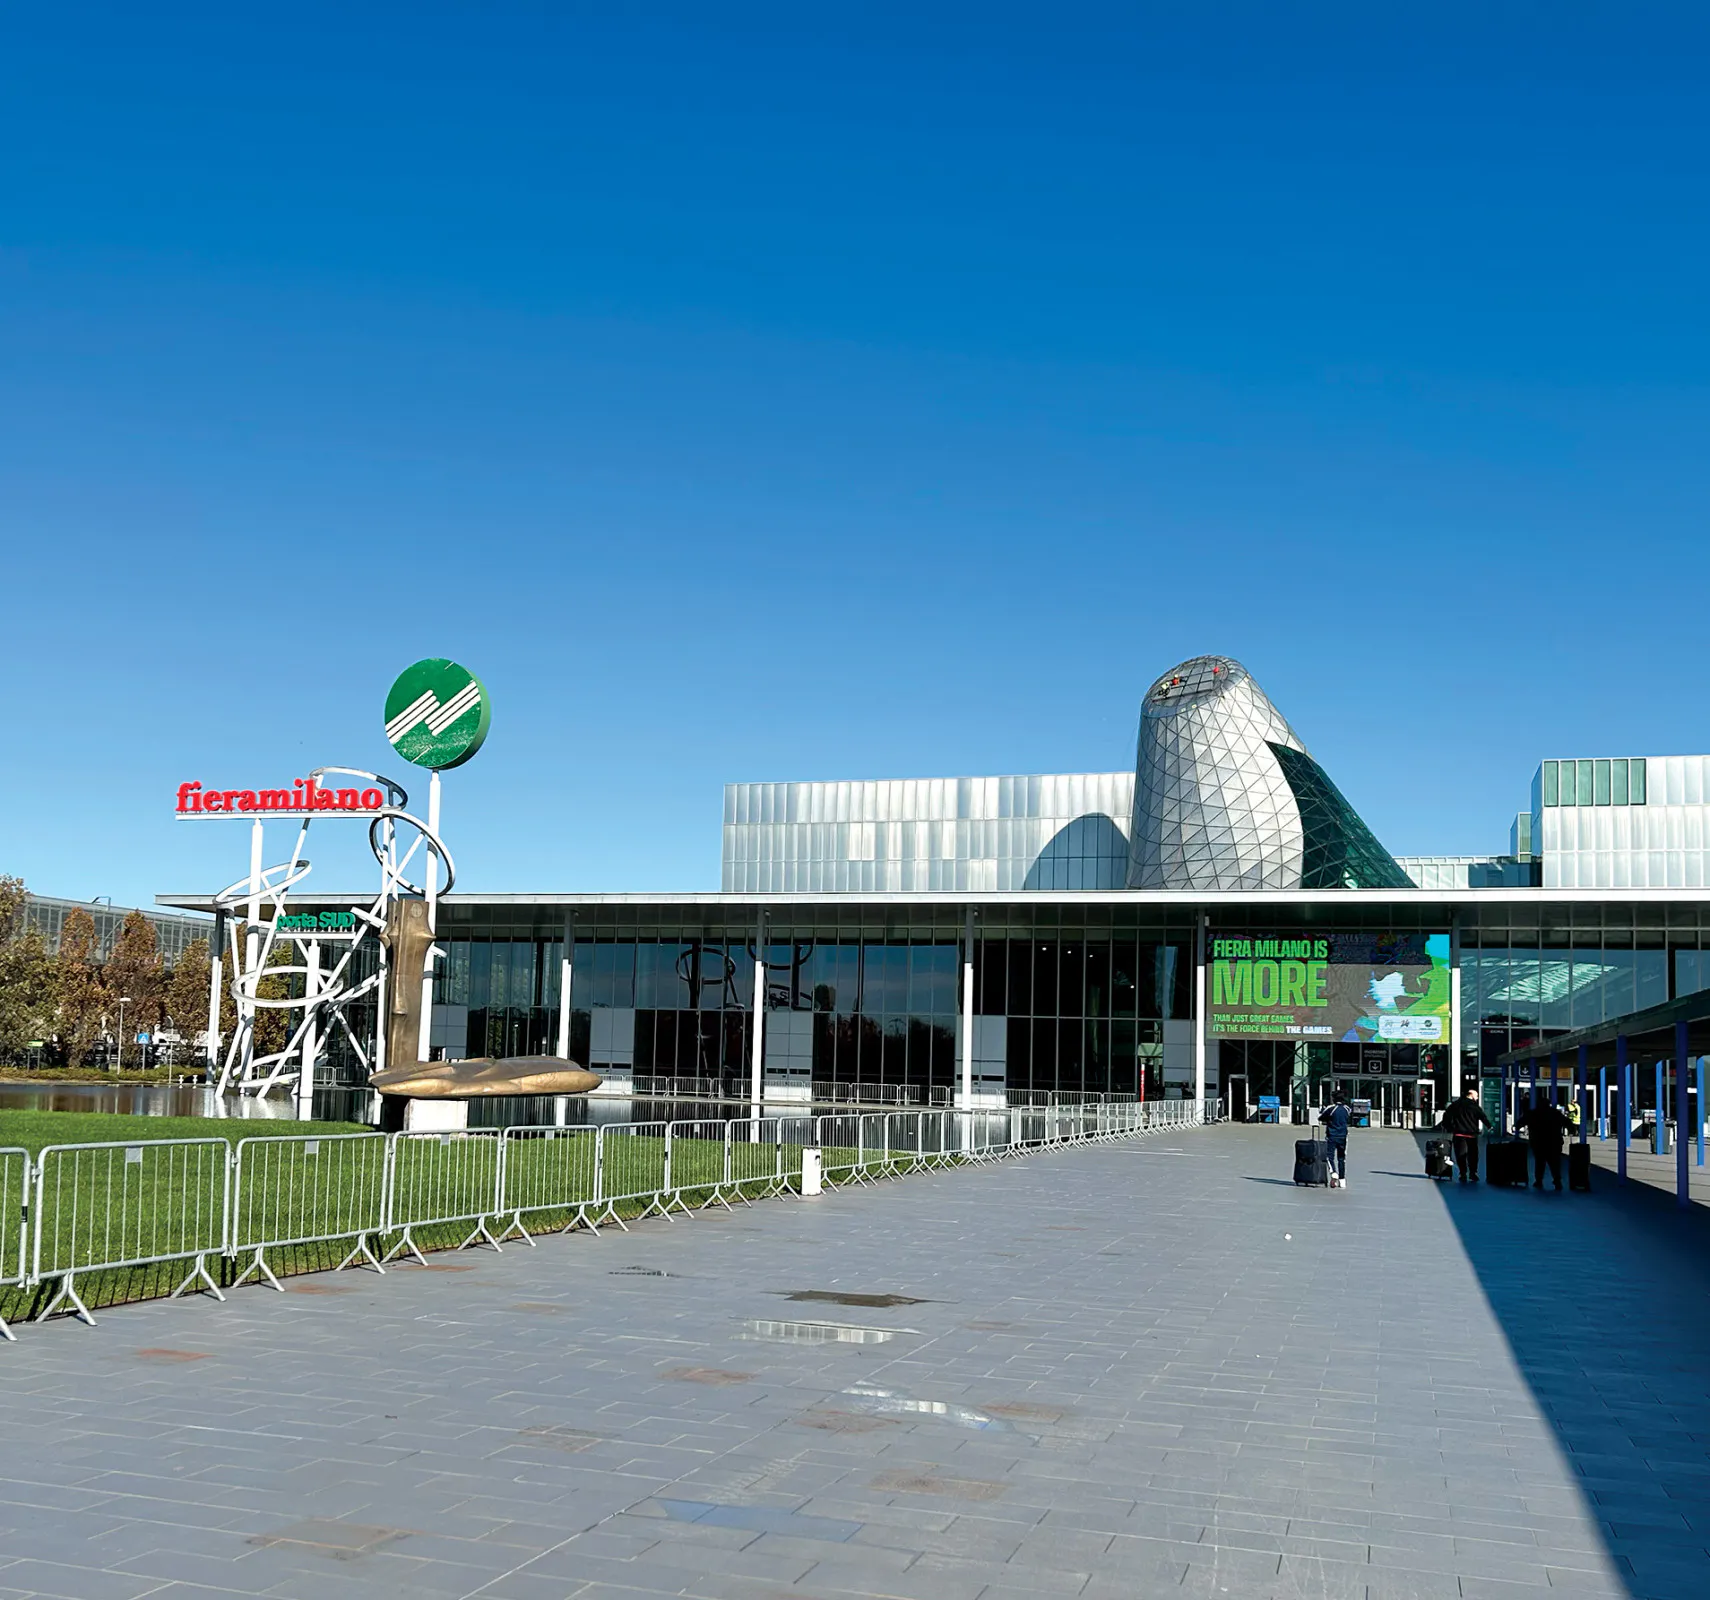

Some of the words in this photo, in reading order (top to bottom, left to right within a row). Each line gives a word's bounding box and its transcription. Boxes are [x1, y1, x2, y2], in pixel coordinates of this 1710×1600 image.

[175, 778, 383, 812] fieramilano
[276, 913, 318, 931] porta
[319, 911, 356, 928] SUD
[1213, 939, 1252, 958] FIERA
[1254, 939, 1310, 958] MILANO
[1313, 939, 1328, 958] IS
[1213, 959, 1328, 1007] MORE
[1213, 1014, 1231, 1022] THAN
[1232, 1014, 1249, 1023] JUST
[1249, 1014, 1270, 1023] GREAT
[1226, 1024, 1239, 1033] THE
[1239, 1024, 1260, 1033] FORCE
[1260, 1025, 1285, 1034] BEHIND
[1285, 1026, 1302, 1034] THE
